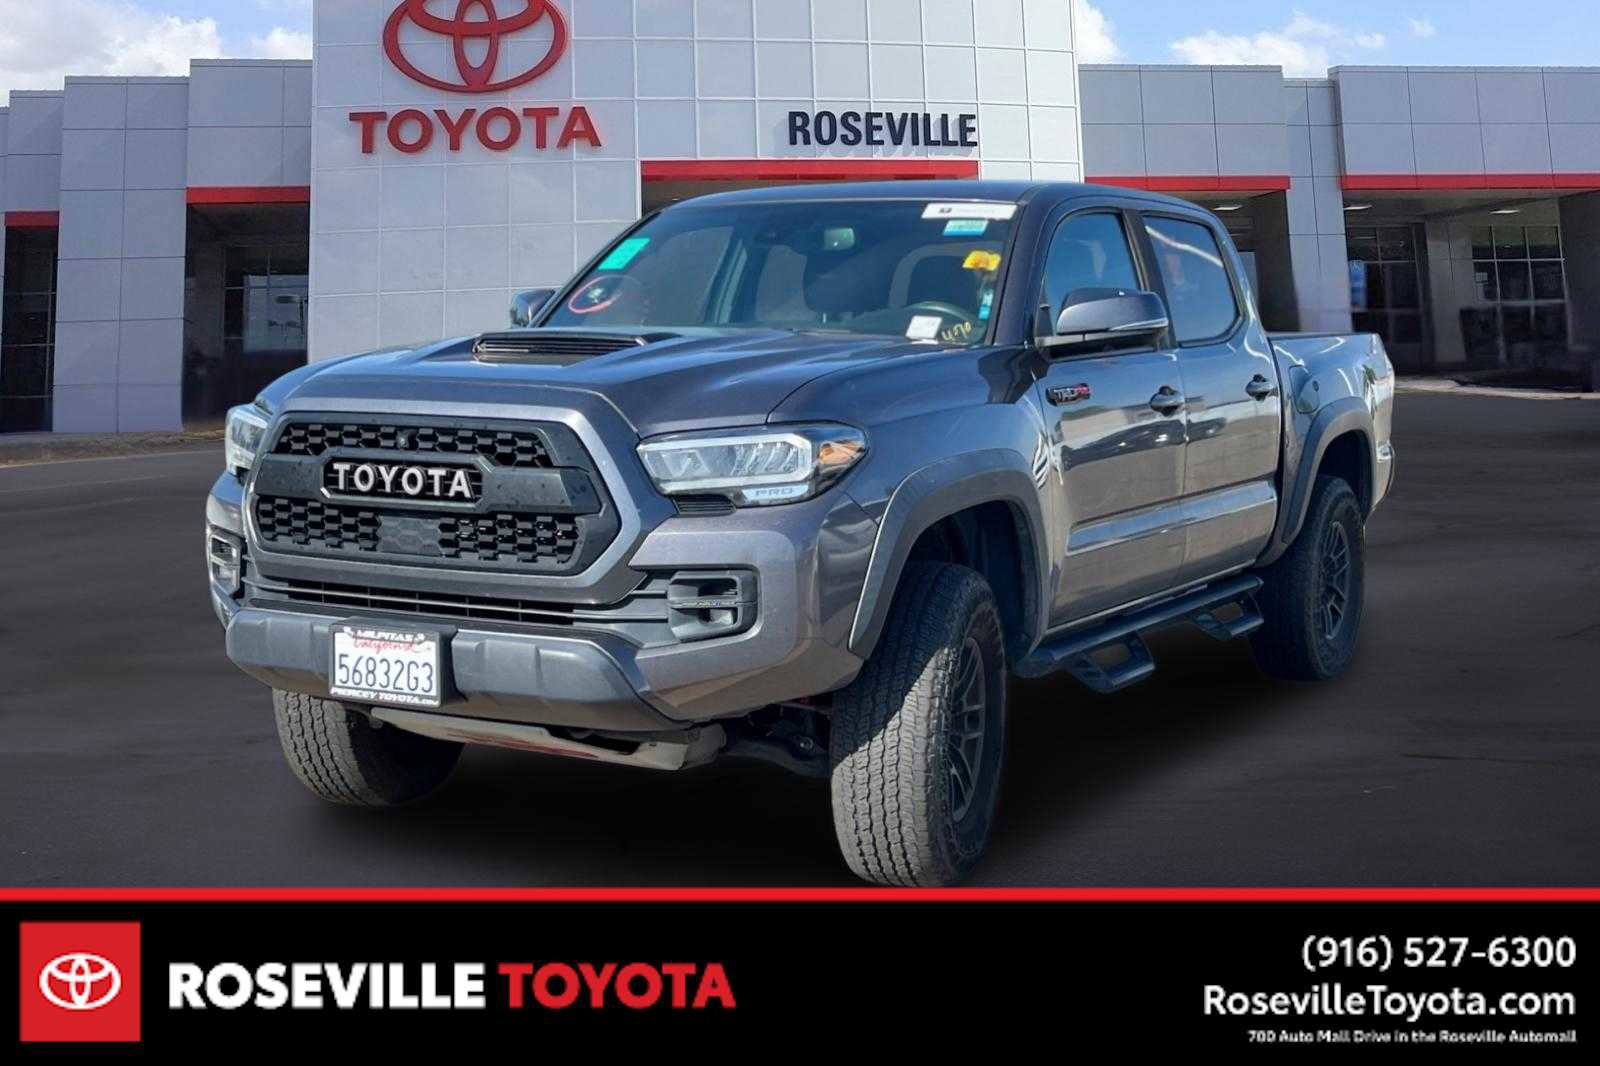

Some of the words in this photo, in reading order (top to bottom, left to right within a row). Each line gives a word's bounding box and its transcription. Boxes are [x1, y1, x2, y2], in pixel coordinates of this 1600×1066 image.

[349, 106, 602, 154] TOYOTA
[788, 110, 978, 147] ROSEVILLE
[333, 462, 472, 498] TOYOTA
[338, 653, 434, 693] 56832G3
